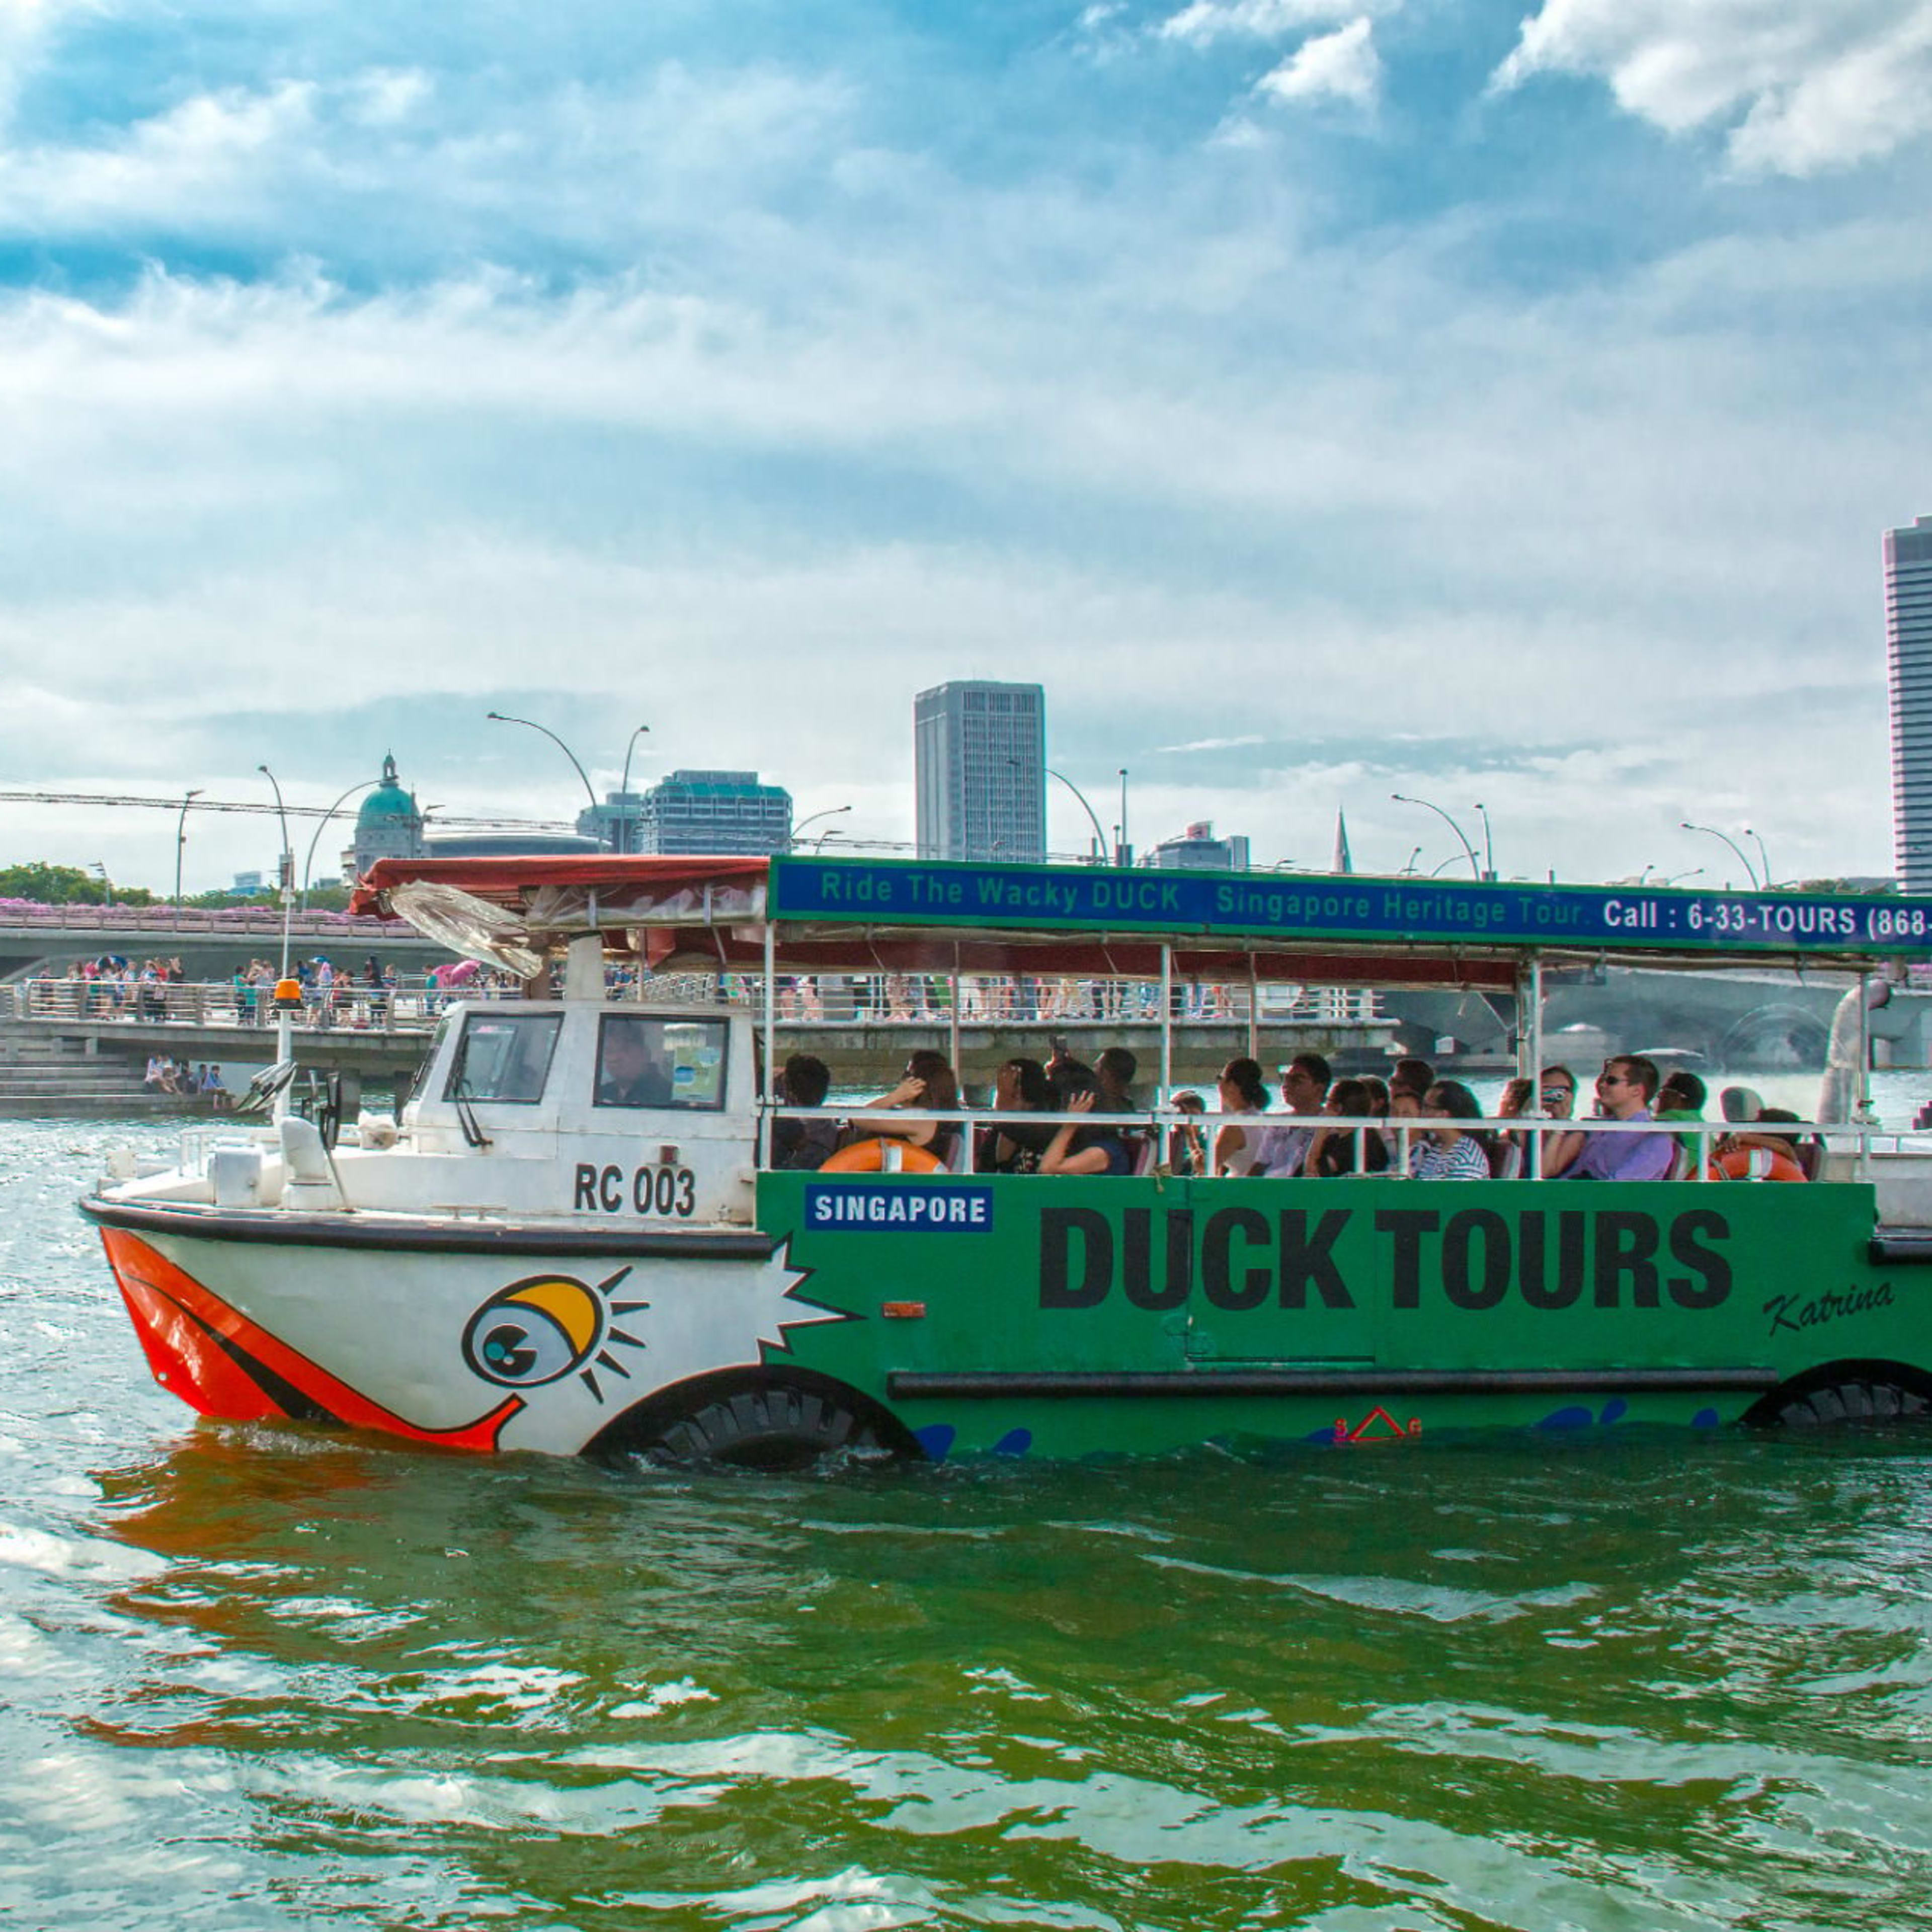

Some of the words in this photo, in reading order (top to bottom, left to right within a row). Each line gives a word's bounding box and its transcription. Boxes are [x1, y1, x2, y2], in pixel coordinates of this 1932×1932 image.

[821, 872, 893, 901] Ride
[907, 875, 962, 903] The
[978, 877, 1078, 913] Wacky
[1092, 881, 1179, 910] DUCK
[1217, 886, 1369, 922] Singapore
[1384, 892, 1505, 927] Heritage
[1603, 900, 1657, 928] Call
[1687, 904, 1856, 934] 6-33-TOURS
[575, 1163, 623, 1213] RC
[633, 1166, 695, 1217] 003
[815, 1195, 986, 1222] SINGAPORE
[1039, 1207, 1356, 1310] DUCK
[1375, 1209, 1732, 1310] TOURS
[1762, 1282, 1894, 1336] Katrina
